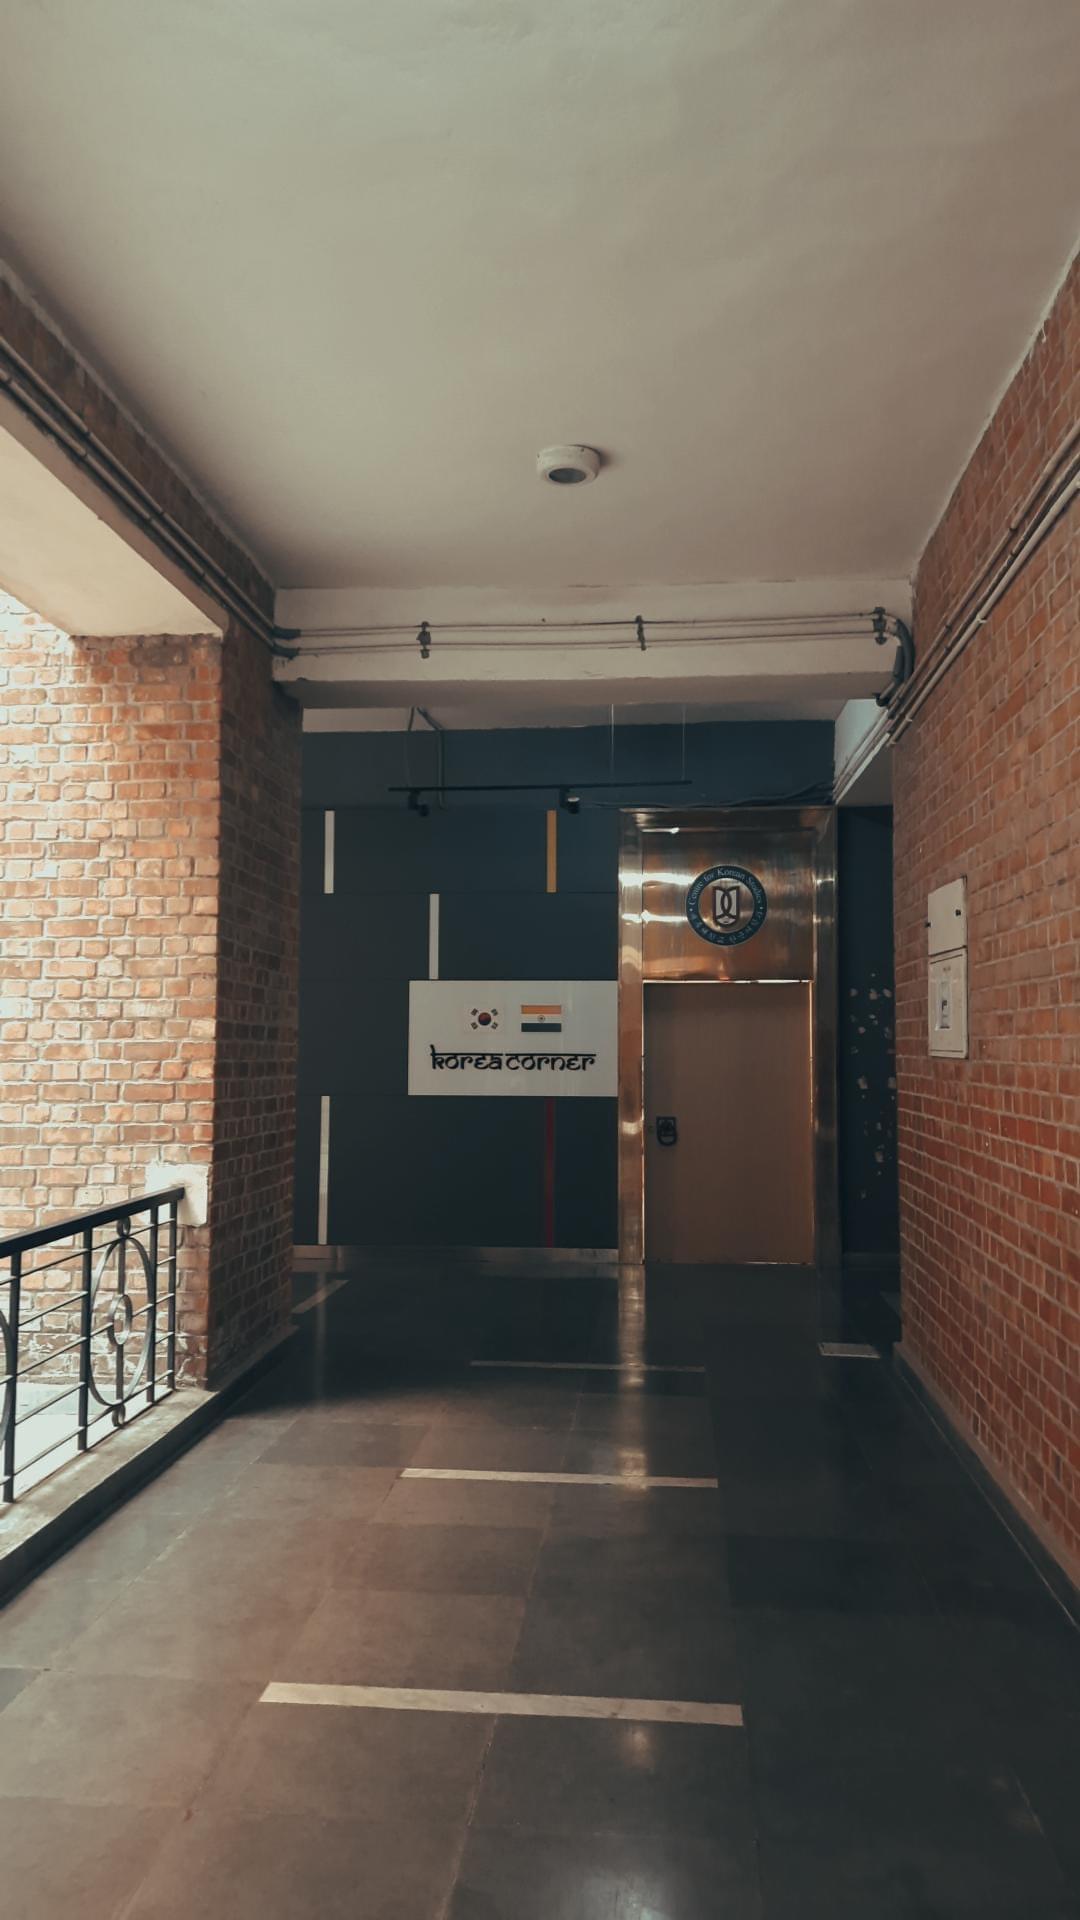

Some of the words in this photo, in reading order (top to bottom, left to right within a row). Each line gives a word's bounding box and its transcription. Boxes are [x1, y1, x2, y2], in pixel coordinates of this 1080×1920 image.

[703, 874, 715, 882] for
[717, 868, 745, 880] Korean
[746, 876, 762, 904] Studies
[430, 1044, 502, 1071] korea
[504, 1053, 596, 1071] corner
